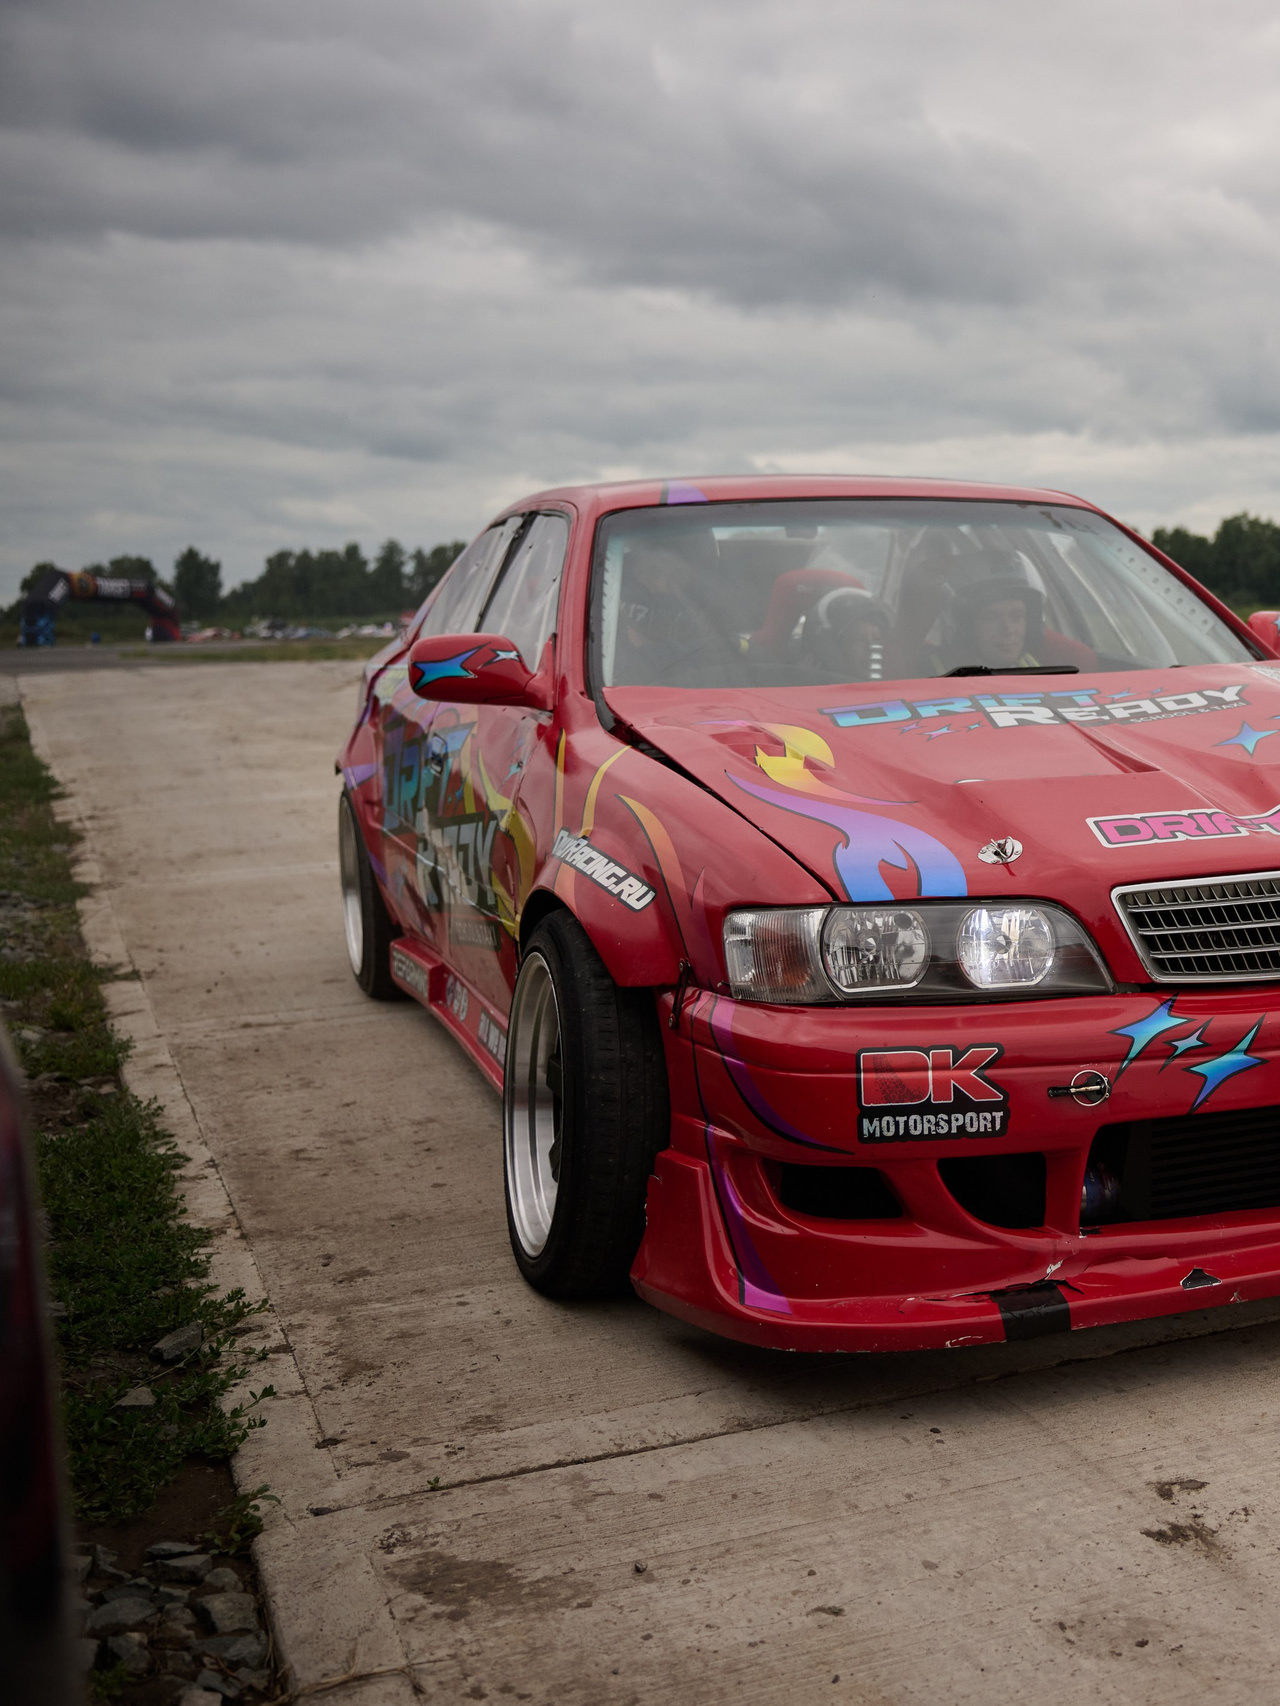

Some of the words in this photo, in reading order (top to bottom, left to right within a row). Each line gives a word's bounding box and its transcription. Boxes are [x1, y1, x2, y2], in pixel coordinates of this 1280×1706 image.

[821, 689, 1098, 727] DRIFT
[986, 685, 1244, 728] READY
[1129, 709, 1196, 723] SCHOOL
[1211, 701, 1247, 711] TAXI
[860, 1047, 1004, 1106] DK
[862, 1111, 1004, 1138] MOTORSPORT
